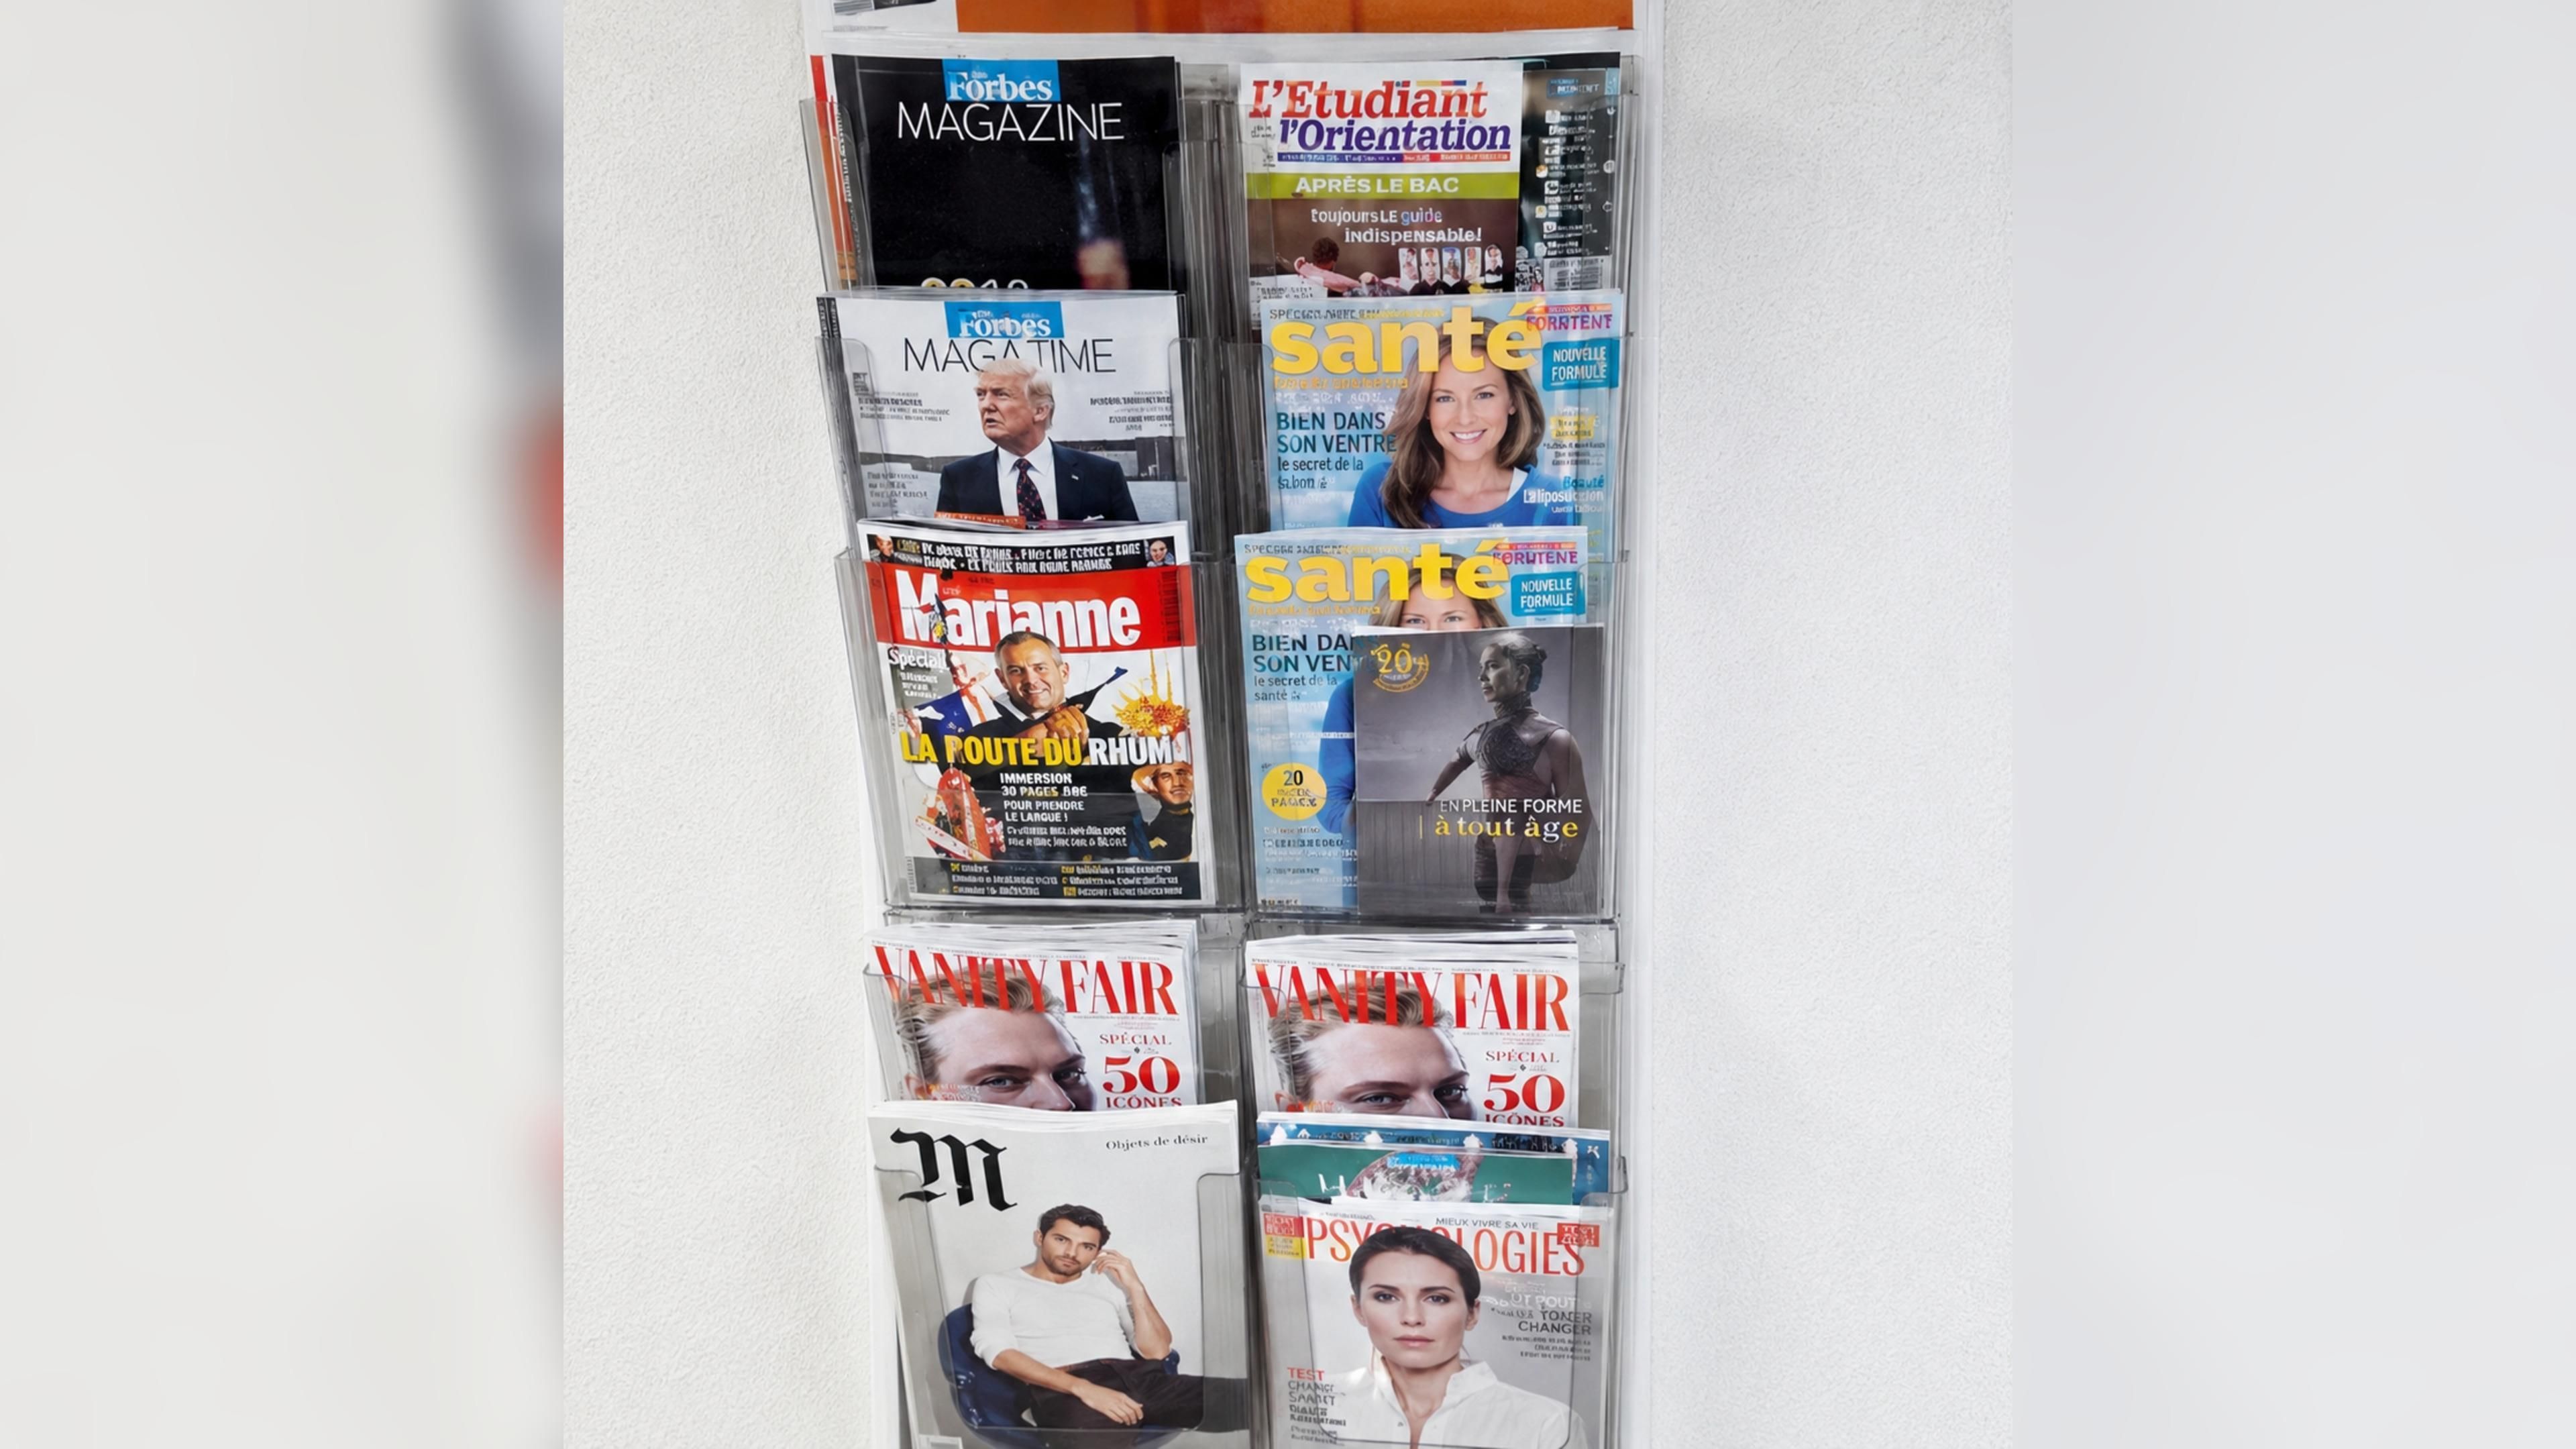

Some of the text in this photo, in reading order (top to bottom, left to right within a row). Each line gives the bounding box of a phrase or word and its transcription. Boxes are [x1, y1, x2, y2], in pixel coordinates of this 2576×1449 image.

[946, 71, 1053, 101] Forbes
[1248, 80, 1488, 119] L'Etudiant
[898, 101, 1125, 142] MAGAZINE
[1279, 119, 1511, 152] l'Orientation
[1376, 178, 1403, 193] LE
[1409, 177, 1460, 193] BAC
[1401, 207, 1442, 225] guide
[957, 309, 1051, 337] Forbes
[1270, 300, 1542, 376] santé
[1553, 345, 1607, 362] NOUVELLE
[1552, 363, 1607, 381] FORMULE
[1277, 412, 1386, 431] BIEN DANS
[1277, 434, 1397, 453] SON VENTRE
[1278, 455, 1363, 472] le secret de la
[1245, 535, 1509, 603] santé
[1521, 578, 1572, 593] NOUVELLE
[896, 570, 1140, 648] Marianne
[1520, 593, 1574, 608] FORMULE
[1252, 634, 1307, 651] BIEN
[1254, 654, 1299, 672] SON
[1377, 648, 1413, 674] 20
[1254, 674, 1338, 687] le secret de la
[1254, 689, 1288, 701] santé
[900, 731, 938, 763] LA
[945, 735, 1038, 766] ROUTE
[1044, 738, 1081, 766] DU
[1000, 772, 1073, 785] IMMERSION
[1284, 769, 1304, 786] 20
[1002, 786, 1018, 797] 30
[1020, 786, 1059, 797] PAGES
[1004, 800, 1085, 811] POUR PRENDRE
[1440, 799, 1582, 814] EN PLEINE FORME
[1005, 812, 1018, 822] LE
[1435, 814, 1578, 843] à tout âge
[873, 945, 1179, 1016] VANITY FAIR
[1251, 963, 1570, 1031] VANITY FAIR
[1102, 1055, 1181, 1095] 50
[1483, 1073, 1565, 1114] 50
[1106, 1134, 1208, 1152] Objets de désir
[1436, 1218, 1468, 1226] MIEUX
[1472, 1220, 1501, 1228] VIVRE
[1521, 1222, 1539, 1230] VIE
[1305, 1216, 1586, 1276] PSYOGIES
[1518, 1320, 1592, 1336] CHANGER
[1287, 1366, 1324, 1381] TEST
